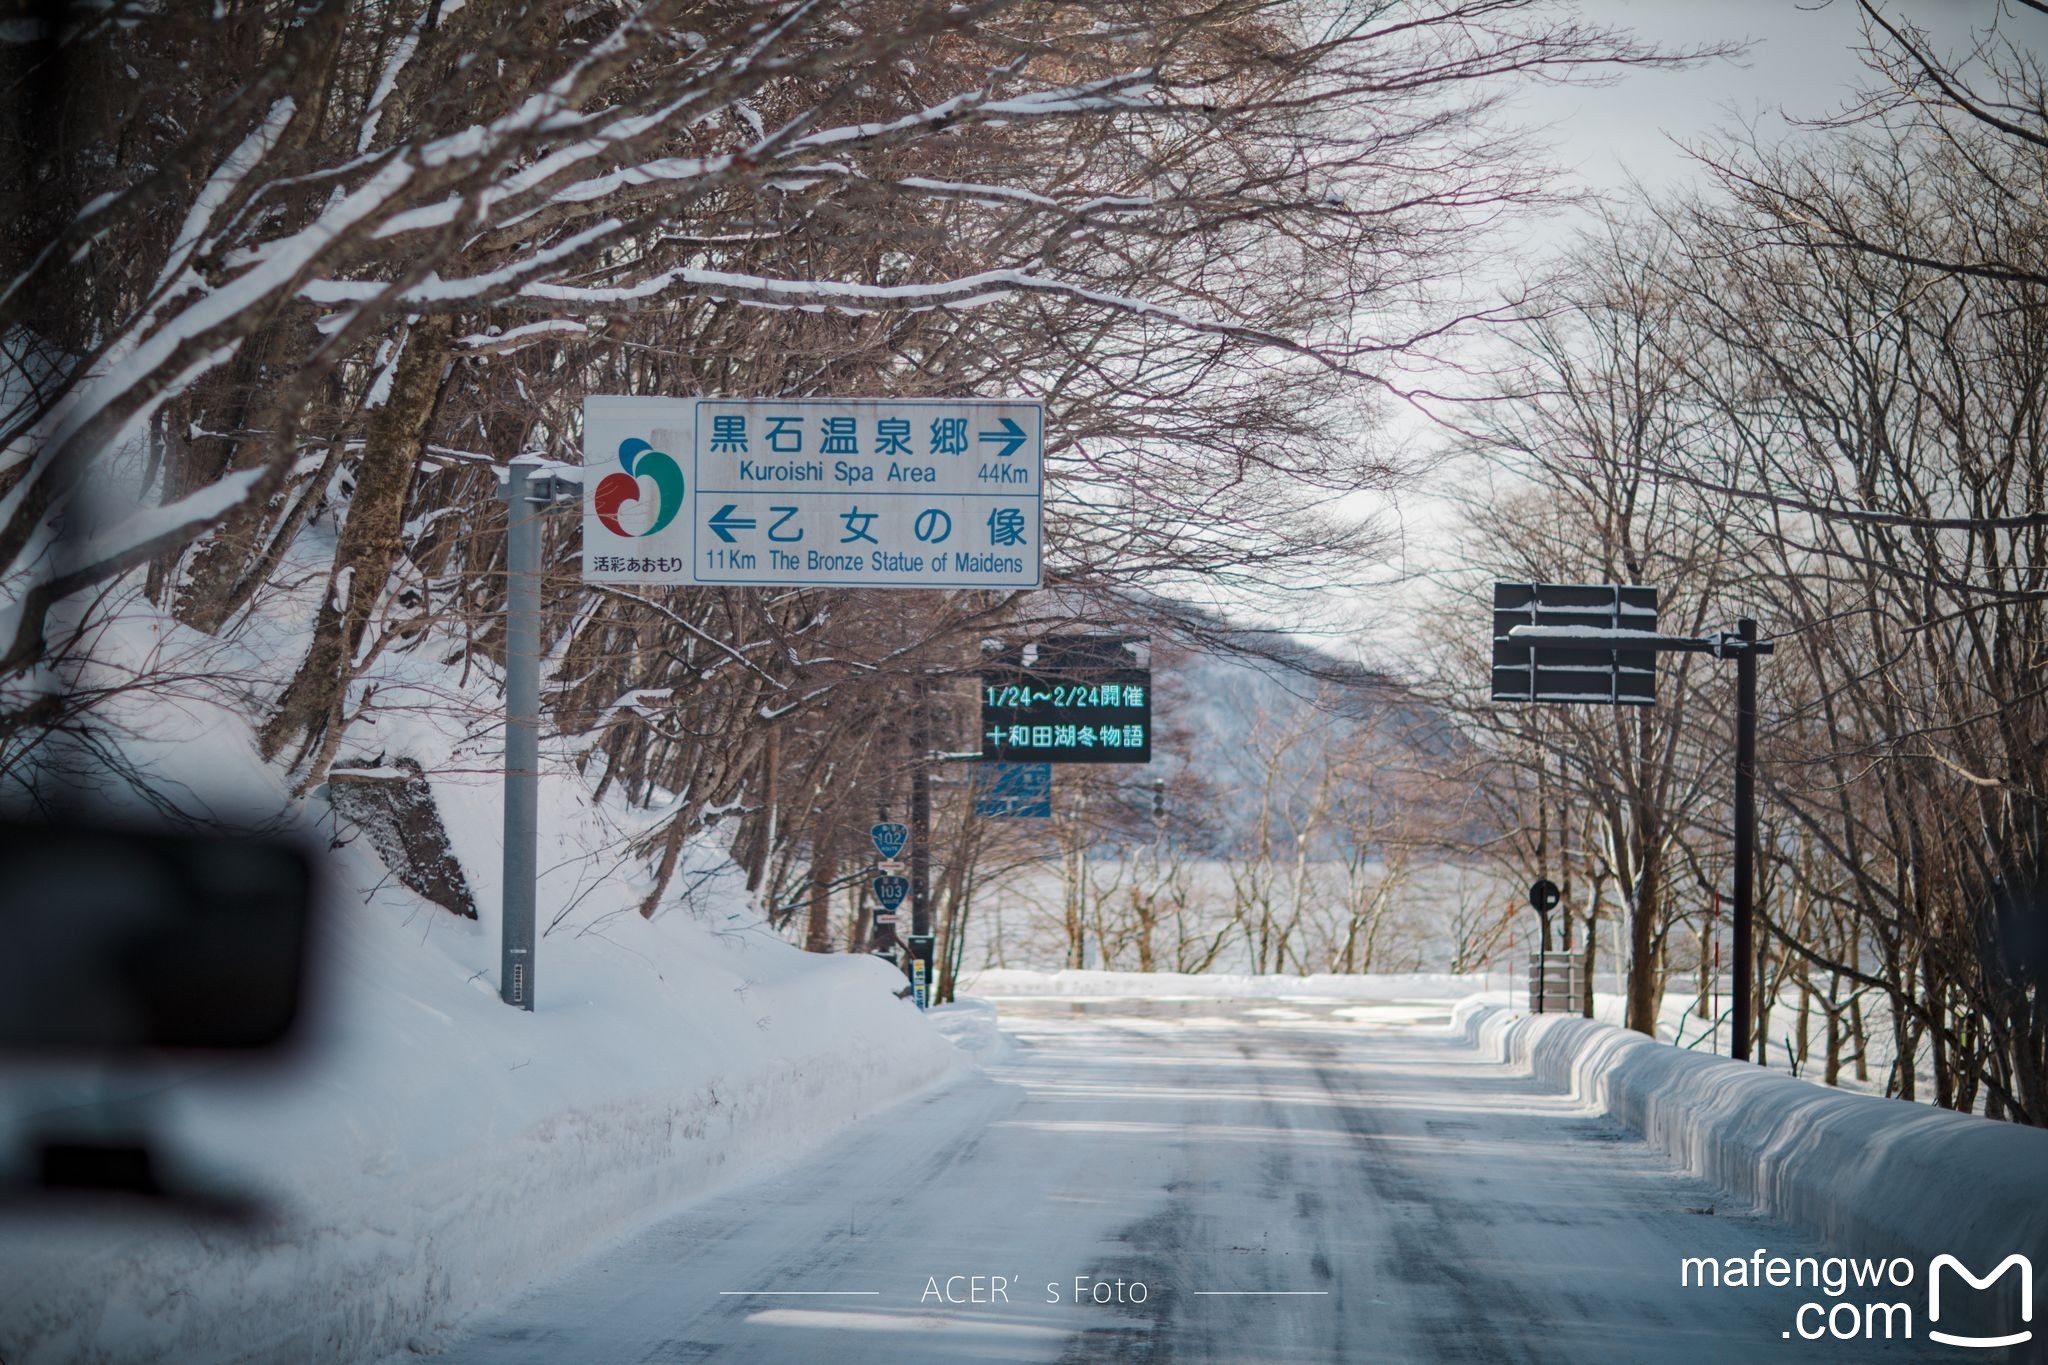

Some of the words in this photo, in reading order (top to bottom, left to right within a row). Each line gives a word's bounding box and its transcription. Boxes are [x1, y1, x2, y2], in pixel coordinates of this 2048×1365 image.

[710, 415, 968, 455] 黒石温泉郷
[740, 461, 823, 481] Kuroishi
[834, 462, 874, 485] Spa
[887, 463, 936, 482] Area
[978, 463, 1028, 484] 44Km
[767, 506, 1028, 546] 乙女の像
[593, 555, 683, 573] 活彩あおもり
[770, 550, 799, 571] The
[807, 550, 864, 572] Bronze
[871, 551, 925, 573] Statue
[931, 551, 948, 573] of
[955, 552, 1023, 574] Maidens
[986, 724, 1144, 748] 十和田湖冬物語
[878, 832, 903, 845] 102
[881, 885, 902, 898] 103
